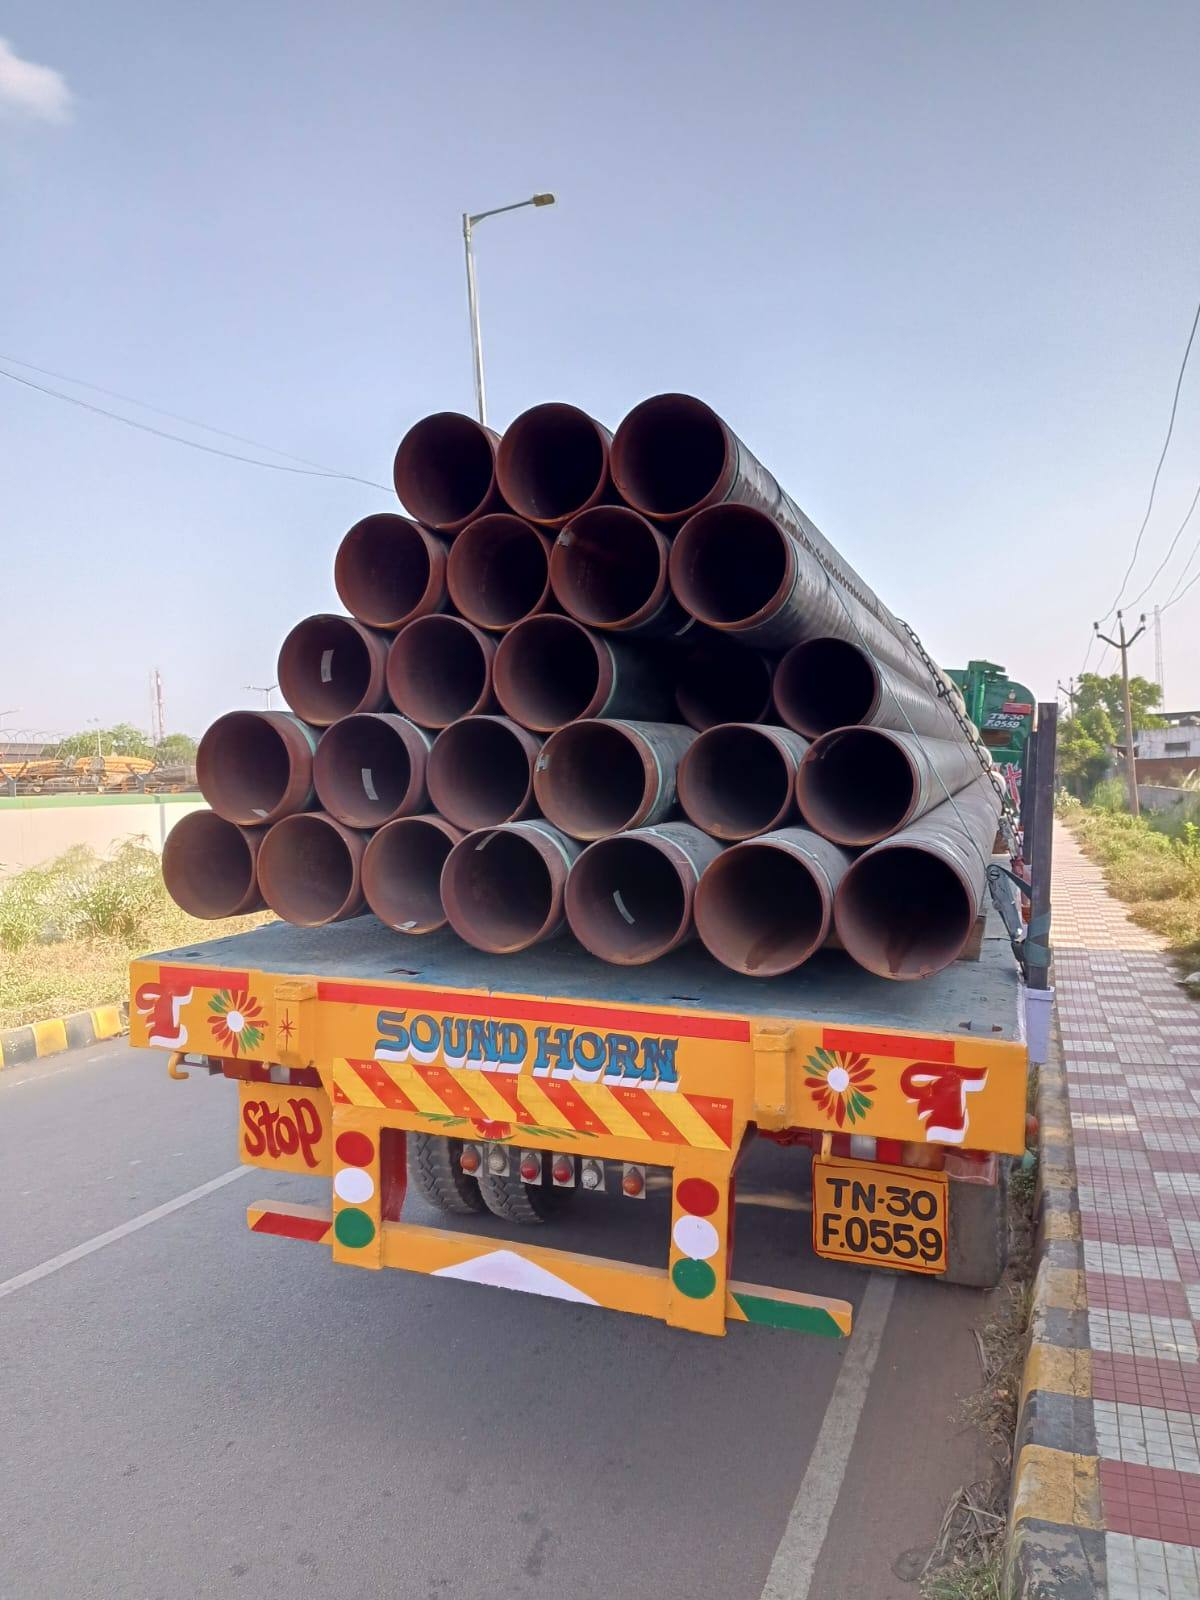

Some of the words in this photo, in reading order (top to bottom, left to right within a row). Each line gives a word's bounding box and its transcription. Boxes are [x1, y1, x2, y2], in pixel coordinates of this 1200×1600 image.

[374, 1010, 528, 1073] SOUND
[531, 1026, 681, 1092] HORN
[826, 1177, 938, 1221] TN-30
[821, 1212, 943, 1265] F.0559
